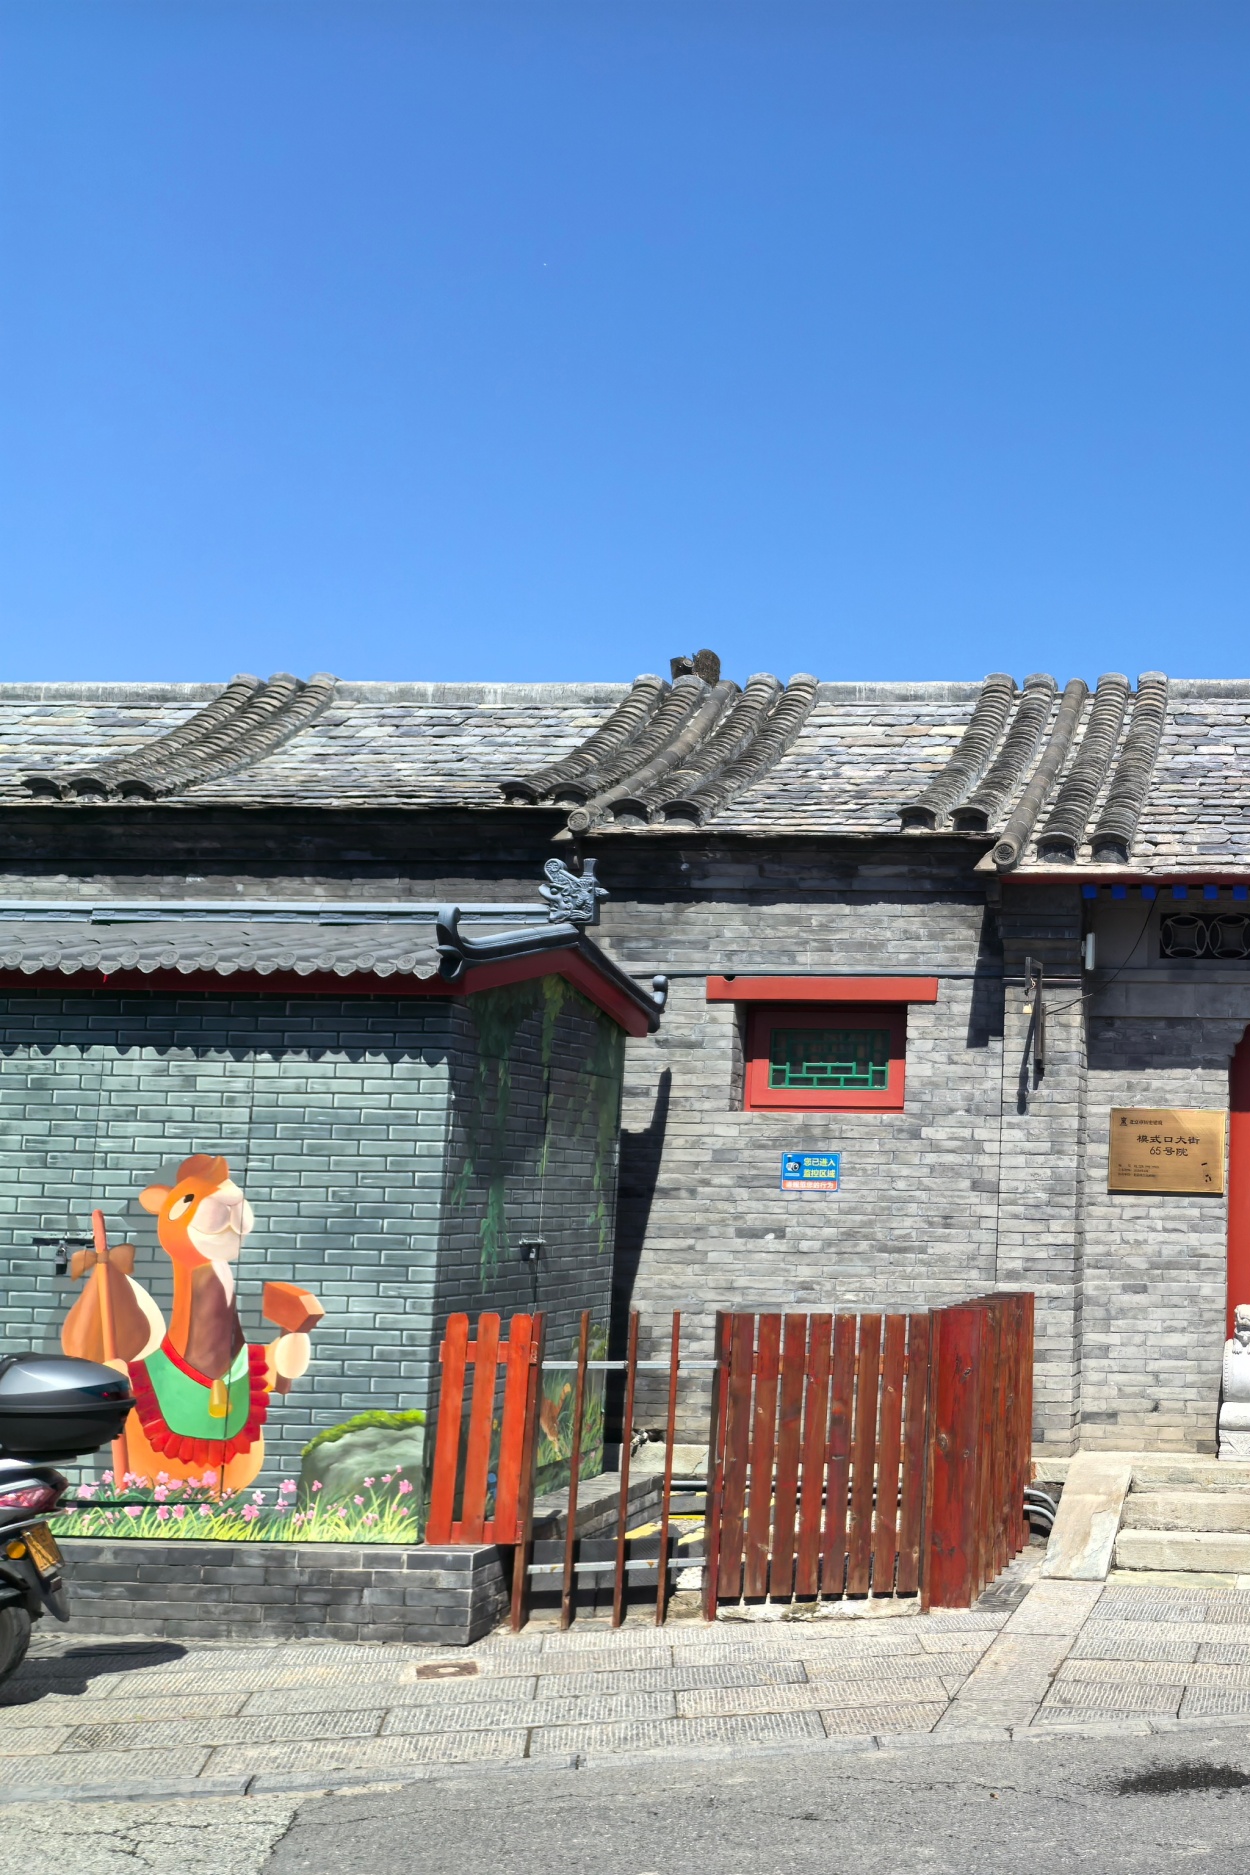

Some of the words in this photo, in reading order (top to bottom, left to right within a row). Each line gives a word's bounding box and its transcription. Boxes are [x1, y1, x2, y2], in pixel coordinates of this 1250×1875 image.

[1136, 1134, 1200, 1145] 模式口大街
[1149, 1146, 1189, 1157] 65号院
[804, 1158, 835, 1166] 您已进入
[803, 1169, 836, 1178] 监控区域
